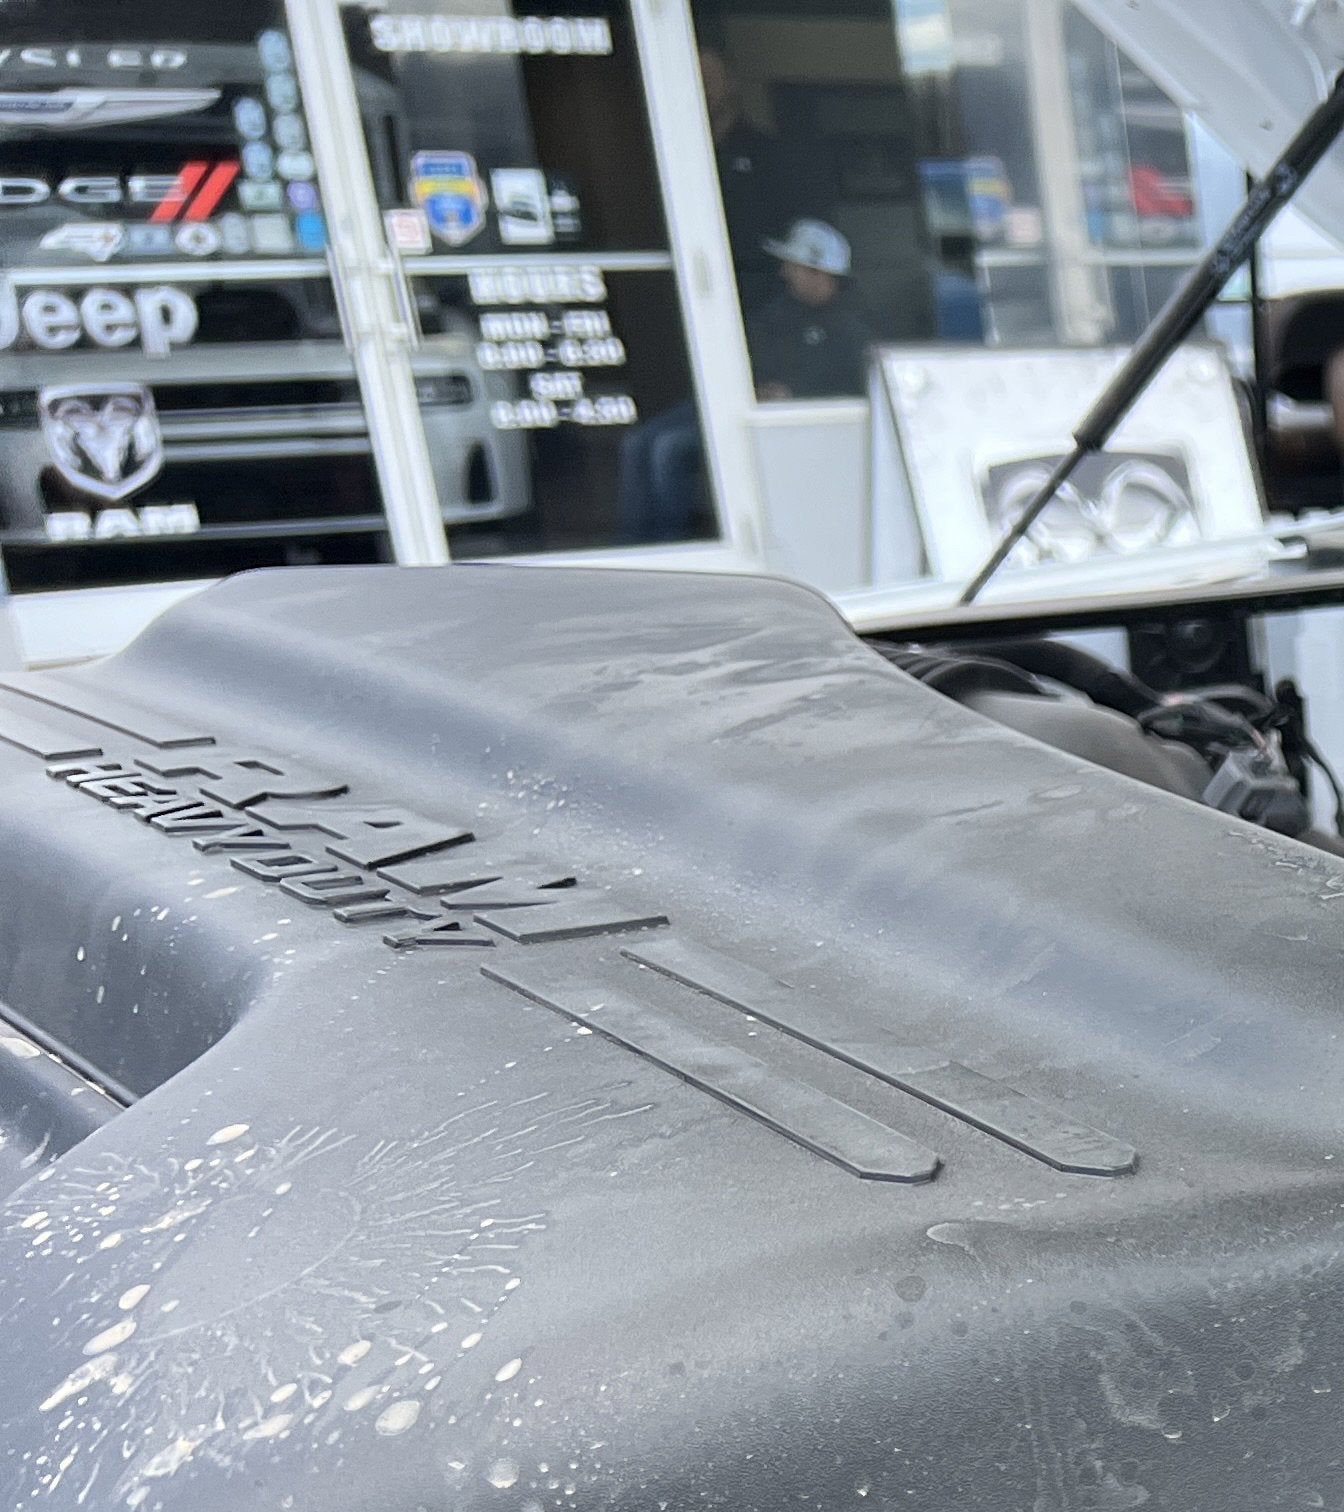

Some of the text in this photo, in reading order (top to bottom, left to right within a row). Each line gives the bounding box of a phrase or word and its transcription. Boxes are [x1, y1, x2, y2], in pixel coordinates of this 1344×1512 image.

[369, 14, 612, 55] SHOWROOM
[46, 503, 200, 541] RAM
[45, 760, 497, 951] HEAVY DUTY
[133, 751, 671, 944] RAM
